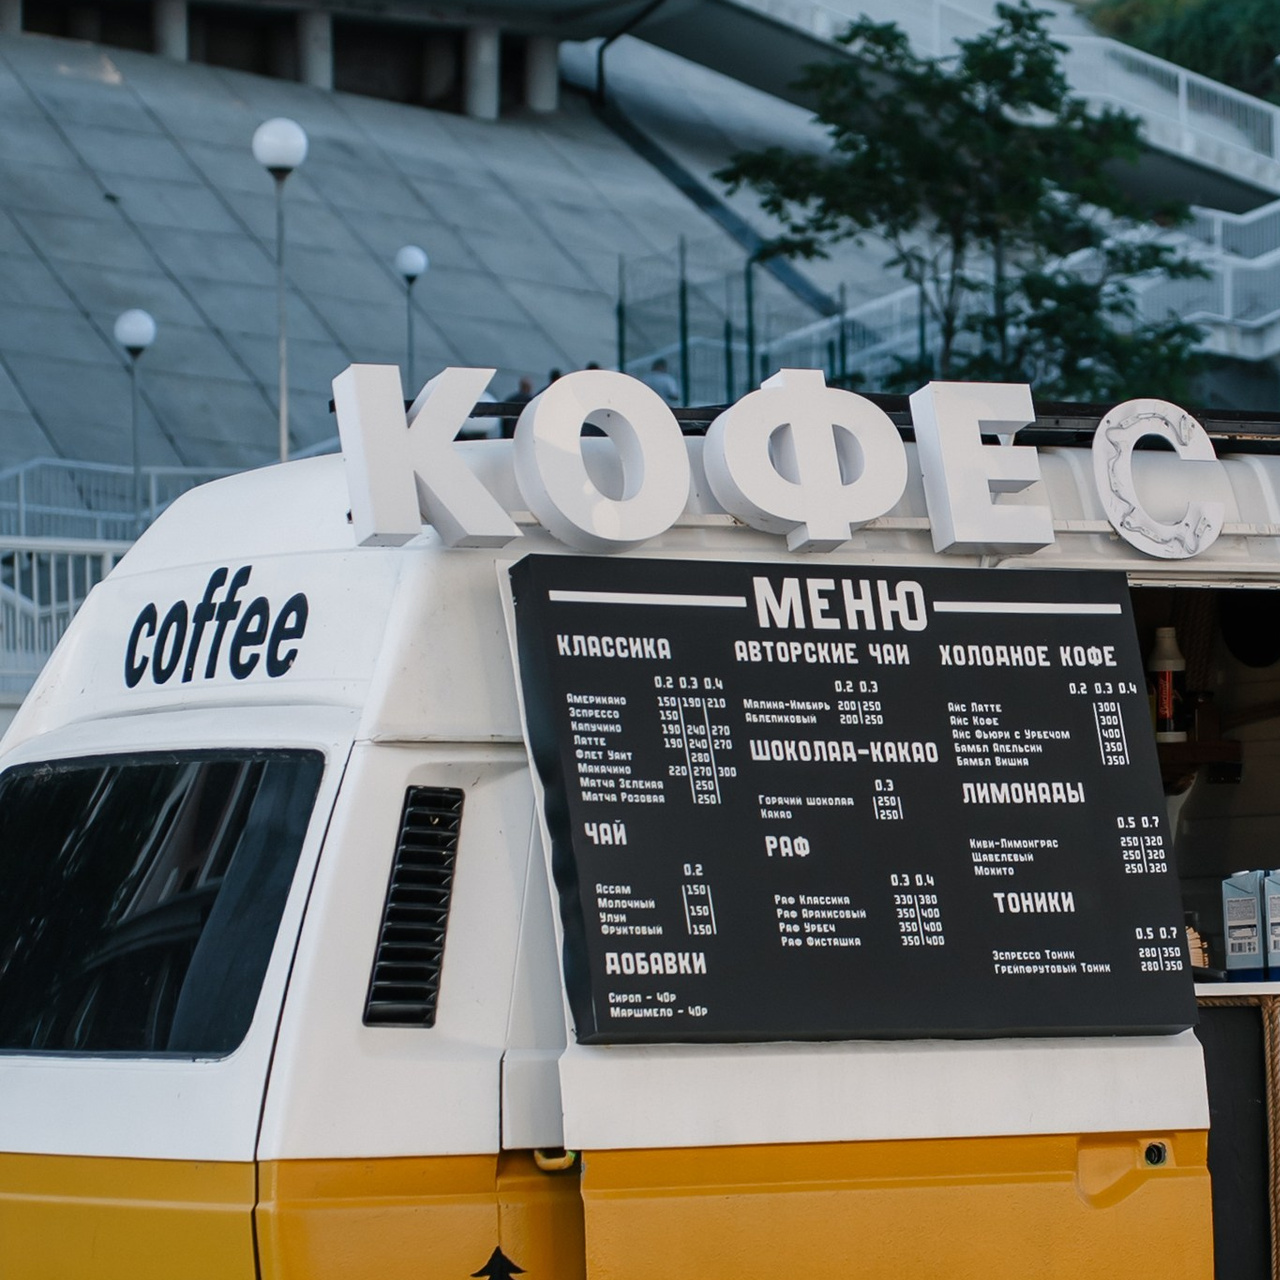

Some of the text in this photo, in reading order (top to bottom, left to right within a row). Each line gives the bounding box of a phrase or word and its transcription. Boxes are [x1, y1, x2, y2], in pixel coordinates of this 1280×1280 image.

[331, 362, 1055, 555] КОФЕ
[1092, 398, 1225, 560] С
[752, 576, 928, 632] МЕНЮ
[124, 565, 310, 689] coffee
[557, 635, 671, 659] КЛАССИКА
[735, 641, 909, 664] АВТОРСКИЕ ЧАИ
[939, 645, 1117, 666] ХОЛОДНОЕ КОФЕ
[654, 676, 723, 689] 0.2 0.3 0.4
[835, 681, 878, 692] 0.2 0.3
[1069, 682, 1137, 694] 0.2 0.3 0.4
[567, 693, 726, 708] Американо 150 190 210
[743, 699, 881, 711] Малина-Имбирь 200 250
[948, 702, 1116, 712] Айс Латте 300
[660, 710, 678, 720] 150
[840, 714, 858, 724] 200
[865, 715, 883, 724] 250
[950, 716, 1118, 725] Айс Кофе 300
[571, 721, 730, 735] Капучино 190 240 270
[952, 729, 970, 739] Айс
[1102, 729, 1120, 738] 400
[574, 735, 732, 749] Латте 190 240 270
[954, 742, 1122, 752] Бамбл Апельсин 350
[576, 749, 602, 759] Флет
[692, 753, 709, 762] 280
[750, 740, 938, 762] ШОКОЛАД-КАКАО
[957, 756, 1125, 766] Бамбл Вишня 350
[669, 766, 687, 776] 220
[694, 767, 712, 776] 270
[718, 767, 736, 777] 300
[580, 777, 615, 787] Матча
[696, 780, 714, 790] 250
[875, 779, 893, 791] 0.3
[582, 791, 716, 804] Матча Розовая 250
[963, 782, 1085, 803] ЛИМОНАДЫ
[759, 795, 802, 805] Горячий
[878, 796, 896, 806] 250
[761, 809, 898, 819] Какао 250
[1117, 816, 1159, 828] 0.5 0.7
[585, 820, 627, 845] ЧАЙ
[765, 836, 810, 857] РАФ
[970, 836, 1162, 848] Киви-Лимонграс 250 320
[1123, 850, 1141, 860] 250
[1147, 849, 1165, 859] 320
[684, 864, 703, 876] 0.2
[1125, 864, 1143, 873] 250
[1149, 863, 1167, 873] 320
[891, 874, 934, 886] 0.3 0.4
[596, 884, 705, 894] Ассам 150
[775, 895, 937, 904] Раф Классика 330 380
[993, 892, 1075, 913] ТОНИКИ
[690, 906, 709, 916] 150
[777, 909, 797, 918] Раф
[897, 908, 915, 918] 350
[921, 908, 940, 918] 400
[601, 925, 712, 935] Фруктовый 150
[779, 922, 942, 932] Раф Урбеч 350 400
[1136, 927, 1177, 939] 0.5 0.7
[781, 936, 944, 946] Раф Фисташка 350 400
[1045, 950, 1075, 959] Тоник
[1139, 948, 1157, 957] 280
[1163, 947, 1180, 957] 350
[606, 953, 706, 974] ДОБАВКИ
[1081, 963, 1110, 972] Тоник
[1141, 961, 1159, 971] 280
[1165, 961, 1183, 971] 350
[609, 993, 641, 1003] Сироп
[610, 1007, 673, 1017] Маршмело
